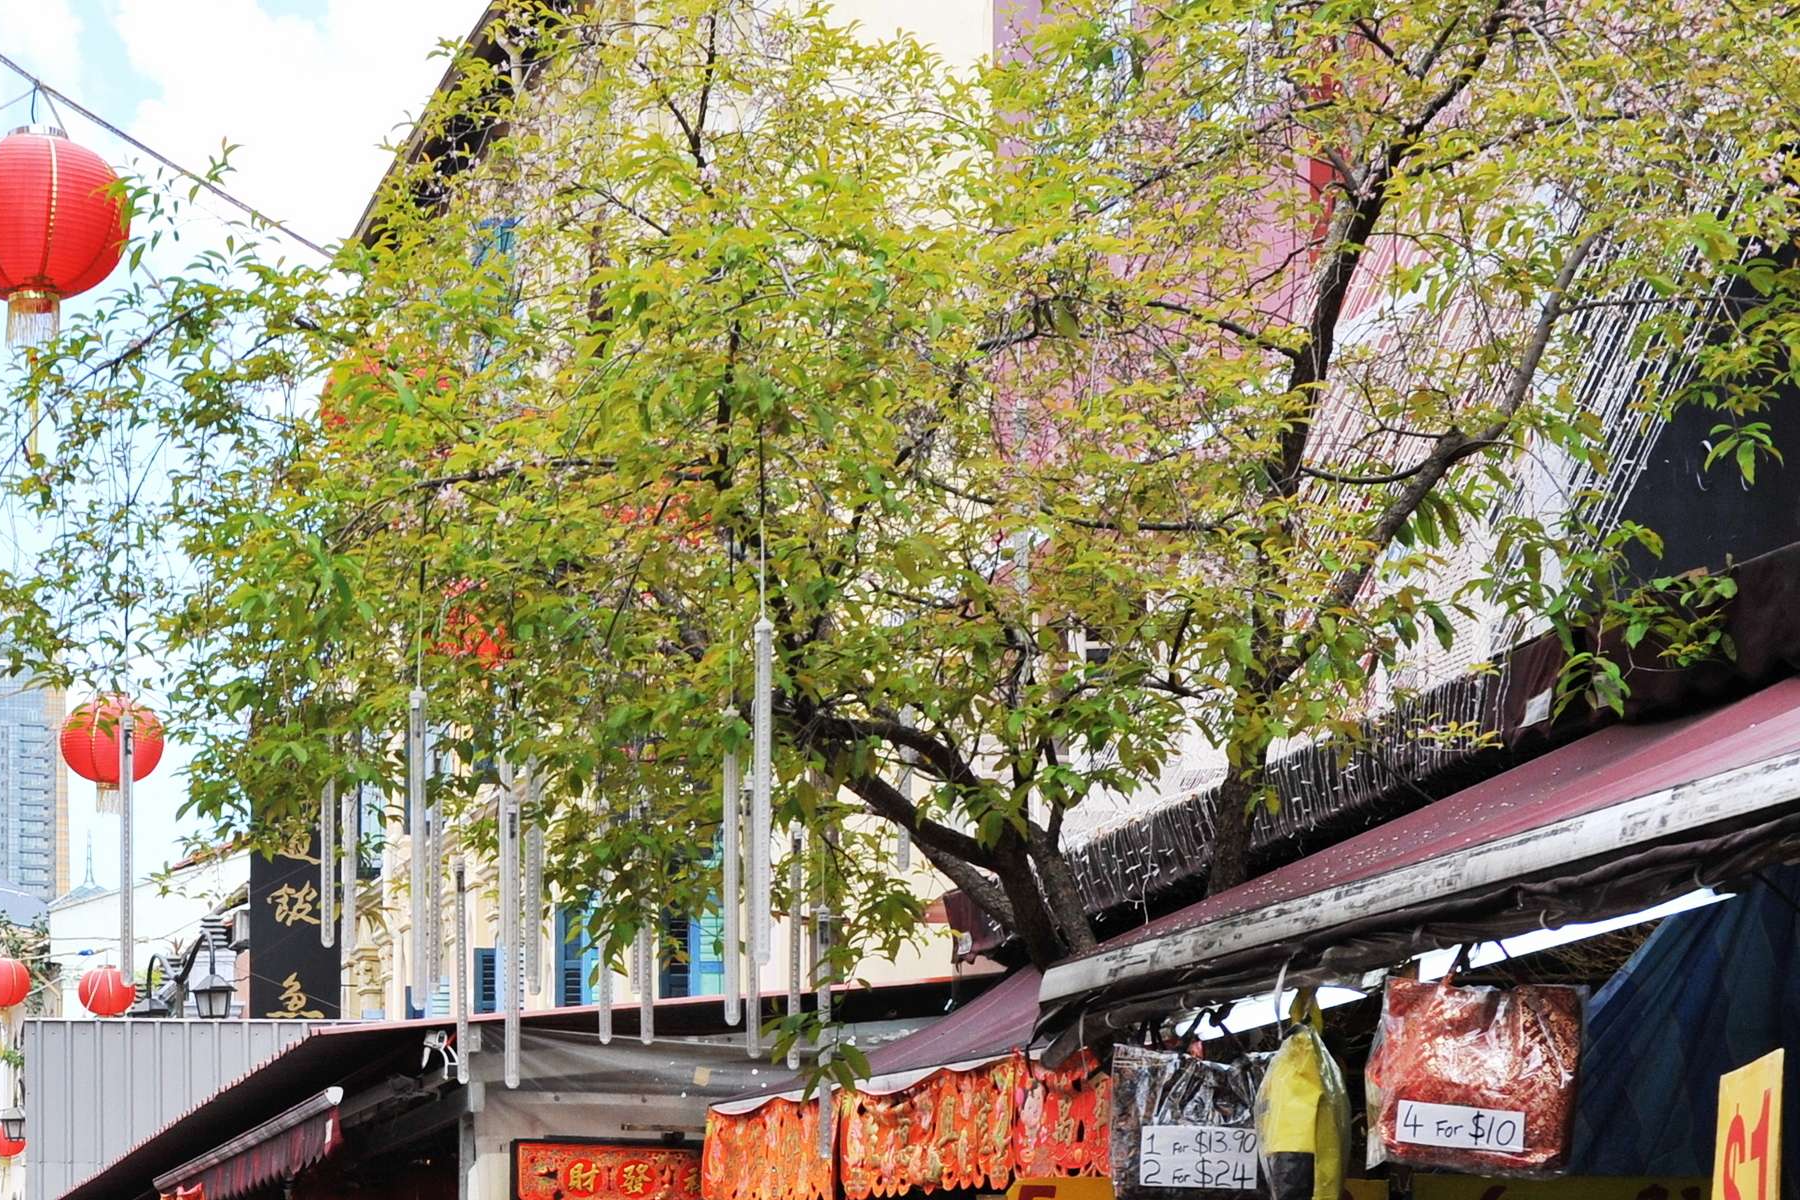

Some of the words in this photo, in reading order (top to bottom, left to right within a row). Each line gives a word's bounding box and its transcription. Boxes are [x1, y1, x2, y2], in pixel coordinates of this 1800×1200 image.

[1403, 1104, 1424, 1138] 4
[1468, 1110, 1517, 1146] $10
[1143, 1133, 1161, 1155] 1
[1192, 1129, 1257, 1157] $13.90
[1143, 1159, 1162, 1184] 2
[1193, 1156, 1254, 1190] $24
